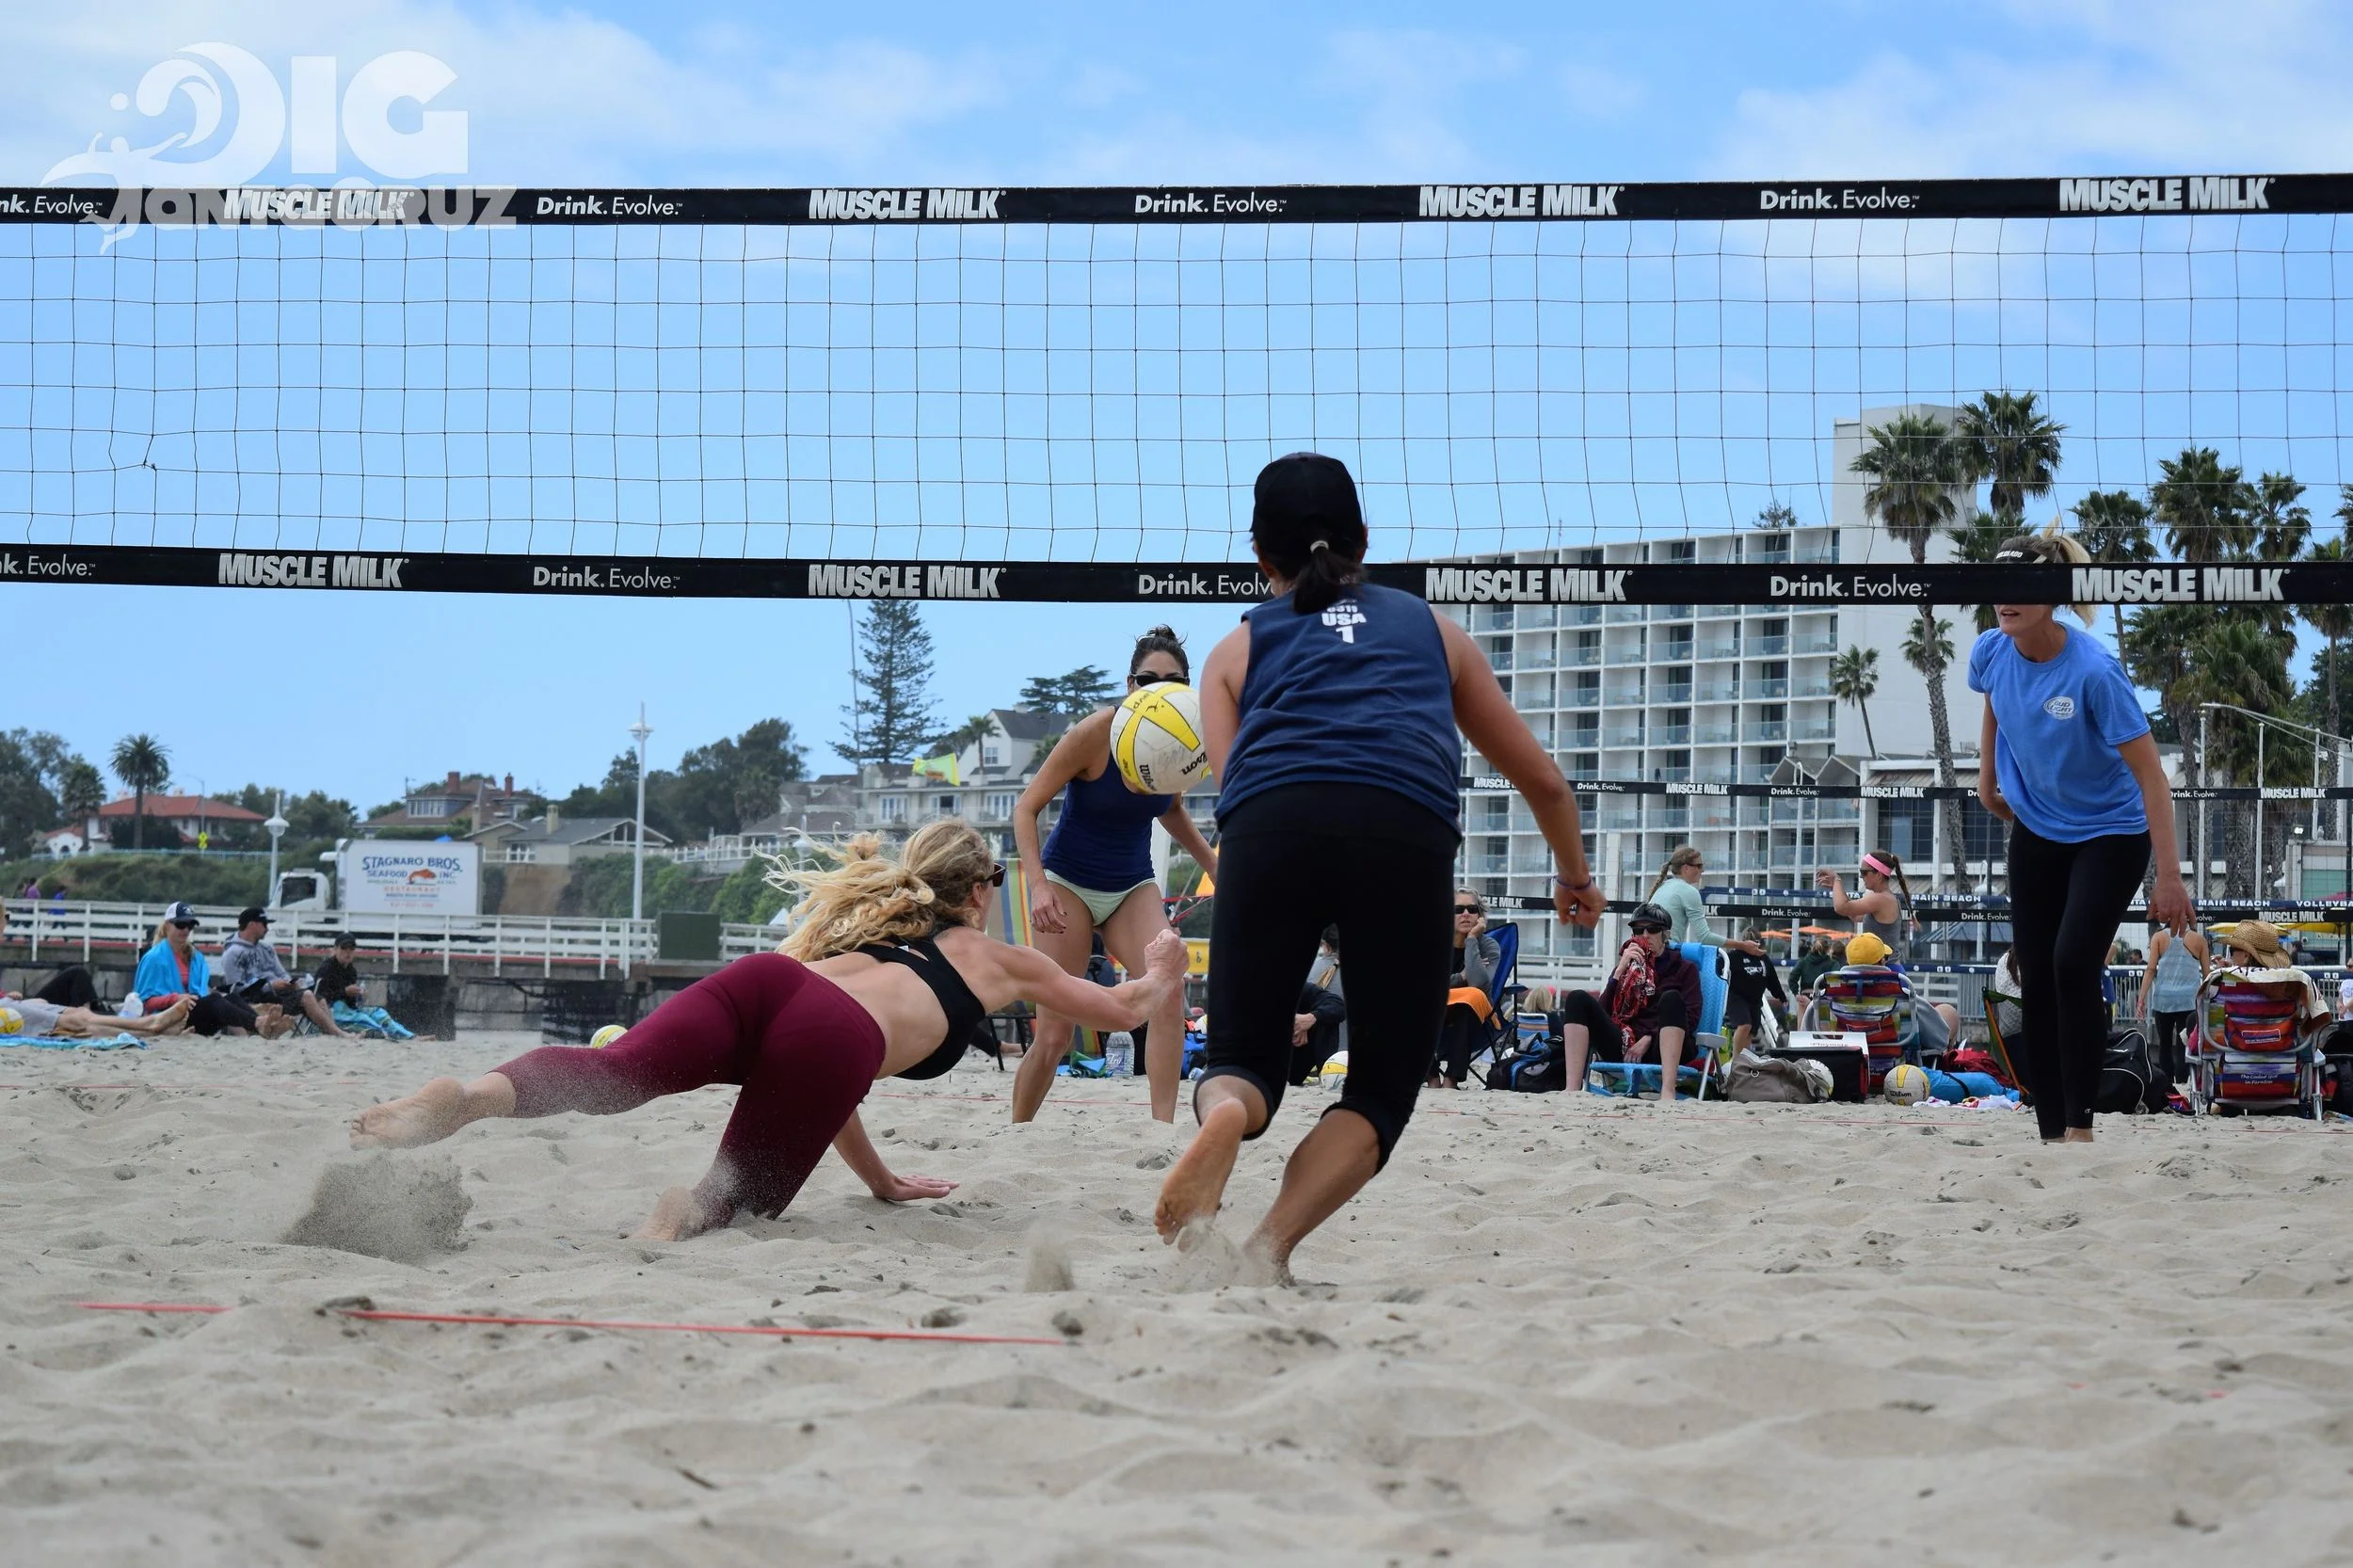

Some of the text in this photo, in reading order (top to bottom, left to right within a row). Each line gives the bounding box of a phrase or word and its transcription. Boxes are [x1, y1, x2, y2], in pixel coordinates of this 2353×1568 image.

[224, 190, 408, 219] MUSCLE MILK
[809, 189, 1000, 219] MUSCLE MILK
[1135, 193, 1209, 213] Drink.
[1419, 185, 1618, 216] MUSCLE MILK
[1761, 188, 1837, 209] Drink.
[2059, 177, 2270, 212] MUSCLE MILK
[537, 196, 607, 215] Drink.
[218, 552, 404, 587] MUSCLE MILK
[534, 566, 604, 587] Drink.
[808, 565, 1000, 598] MUSCLE MILK
[1138, 572, 1271, 595] Drink. Evolv
[1425, 568, 1627, 601] MUSCLE MILK
[1771, 574, 1849, 597] Drink.
[2073, 568, 2286, 601] MUSCLE MILK
[1321, 613, 1367, 626] USA
[1473, 776, 1510, 788] MUSCLE
[1666, 783, 1728, 794] MUSCLE MILK
[1861, 787, 1924, 797] MUSCLE MILK
[2261, 788, 2326, 798] MUSCLE MILK
[362, 856, 424, 871] STAGNARO
[2259, 911, 2324, 922] MUSCLE MILK
